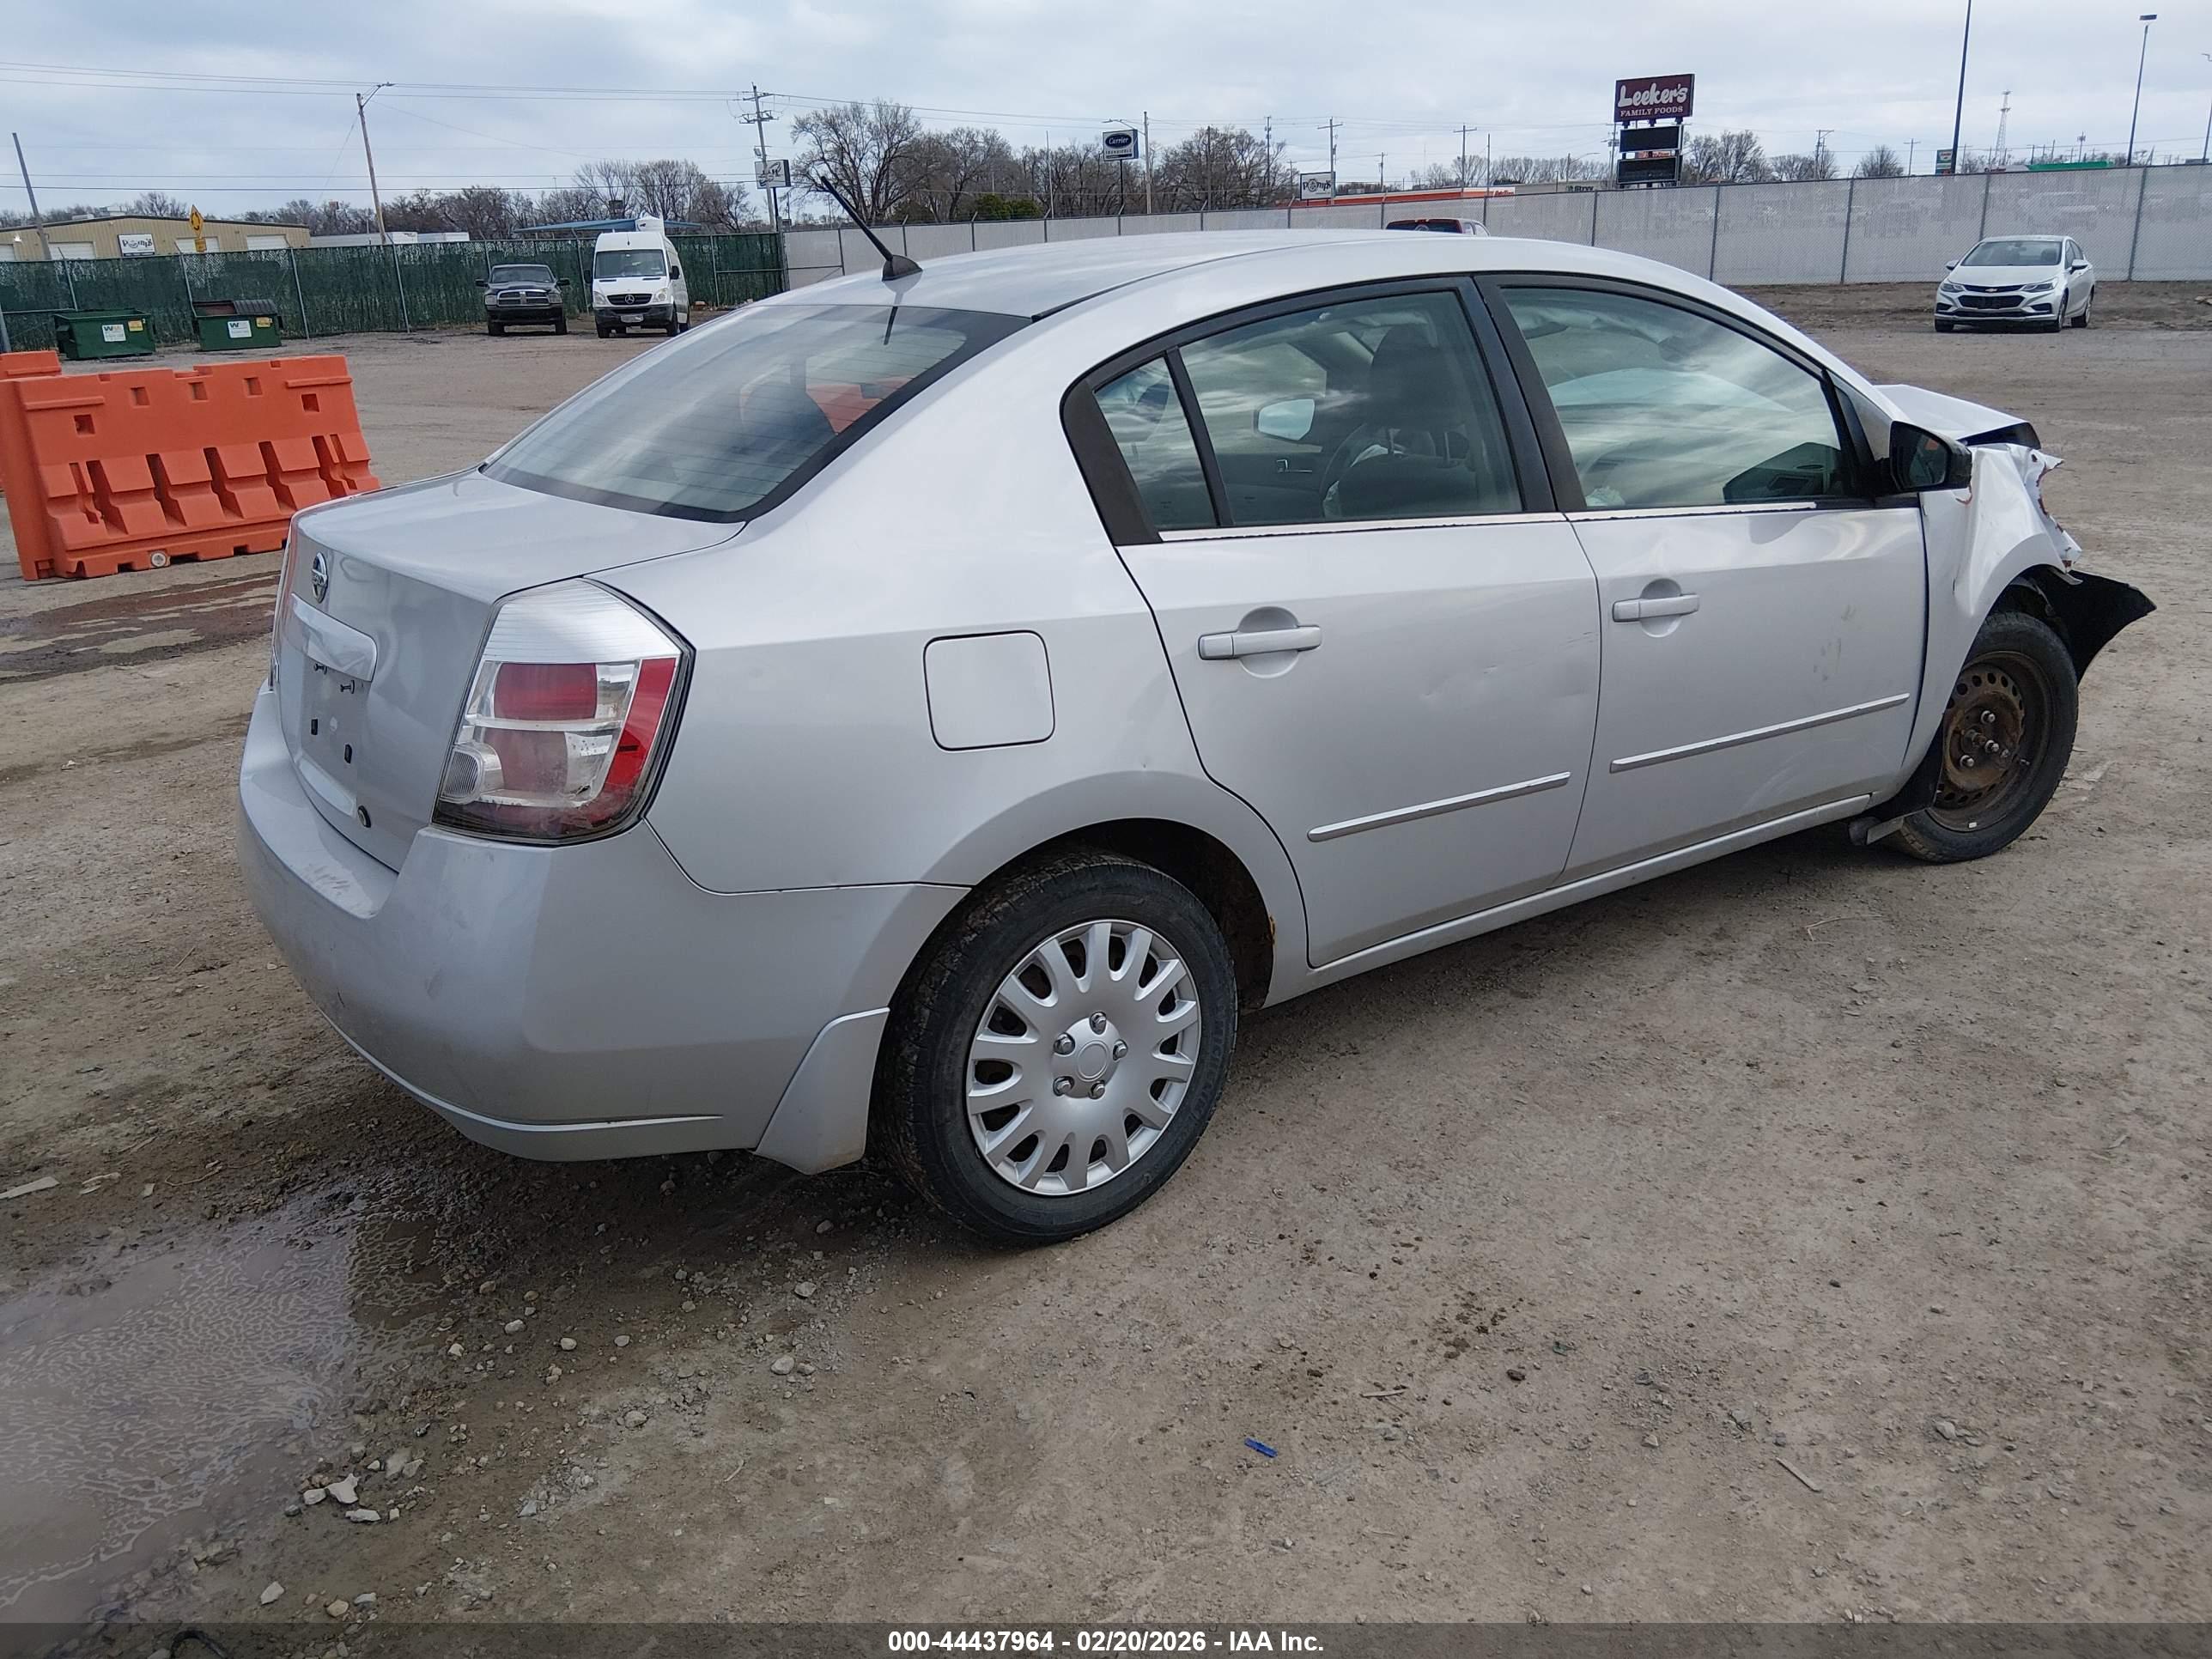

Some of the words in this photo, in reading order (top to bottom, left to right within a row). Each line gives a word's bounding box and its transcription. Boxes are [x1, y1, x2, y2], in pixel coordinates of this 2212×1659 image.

[1618, 82, 1689, 107] Leeker's
[1620, 108, 1652, 117] FAMILY
[1654, 106, 1684, 114] FOODS
[1109, 137, 1129, 145] Carrier
